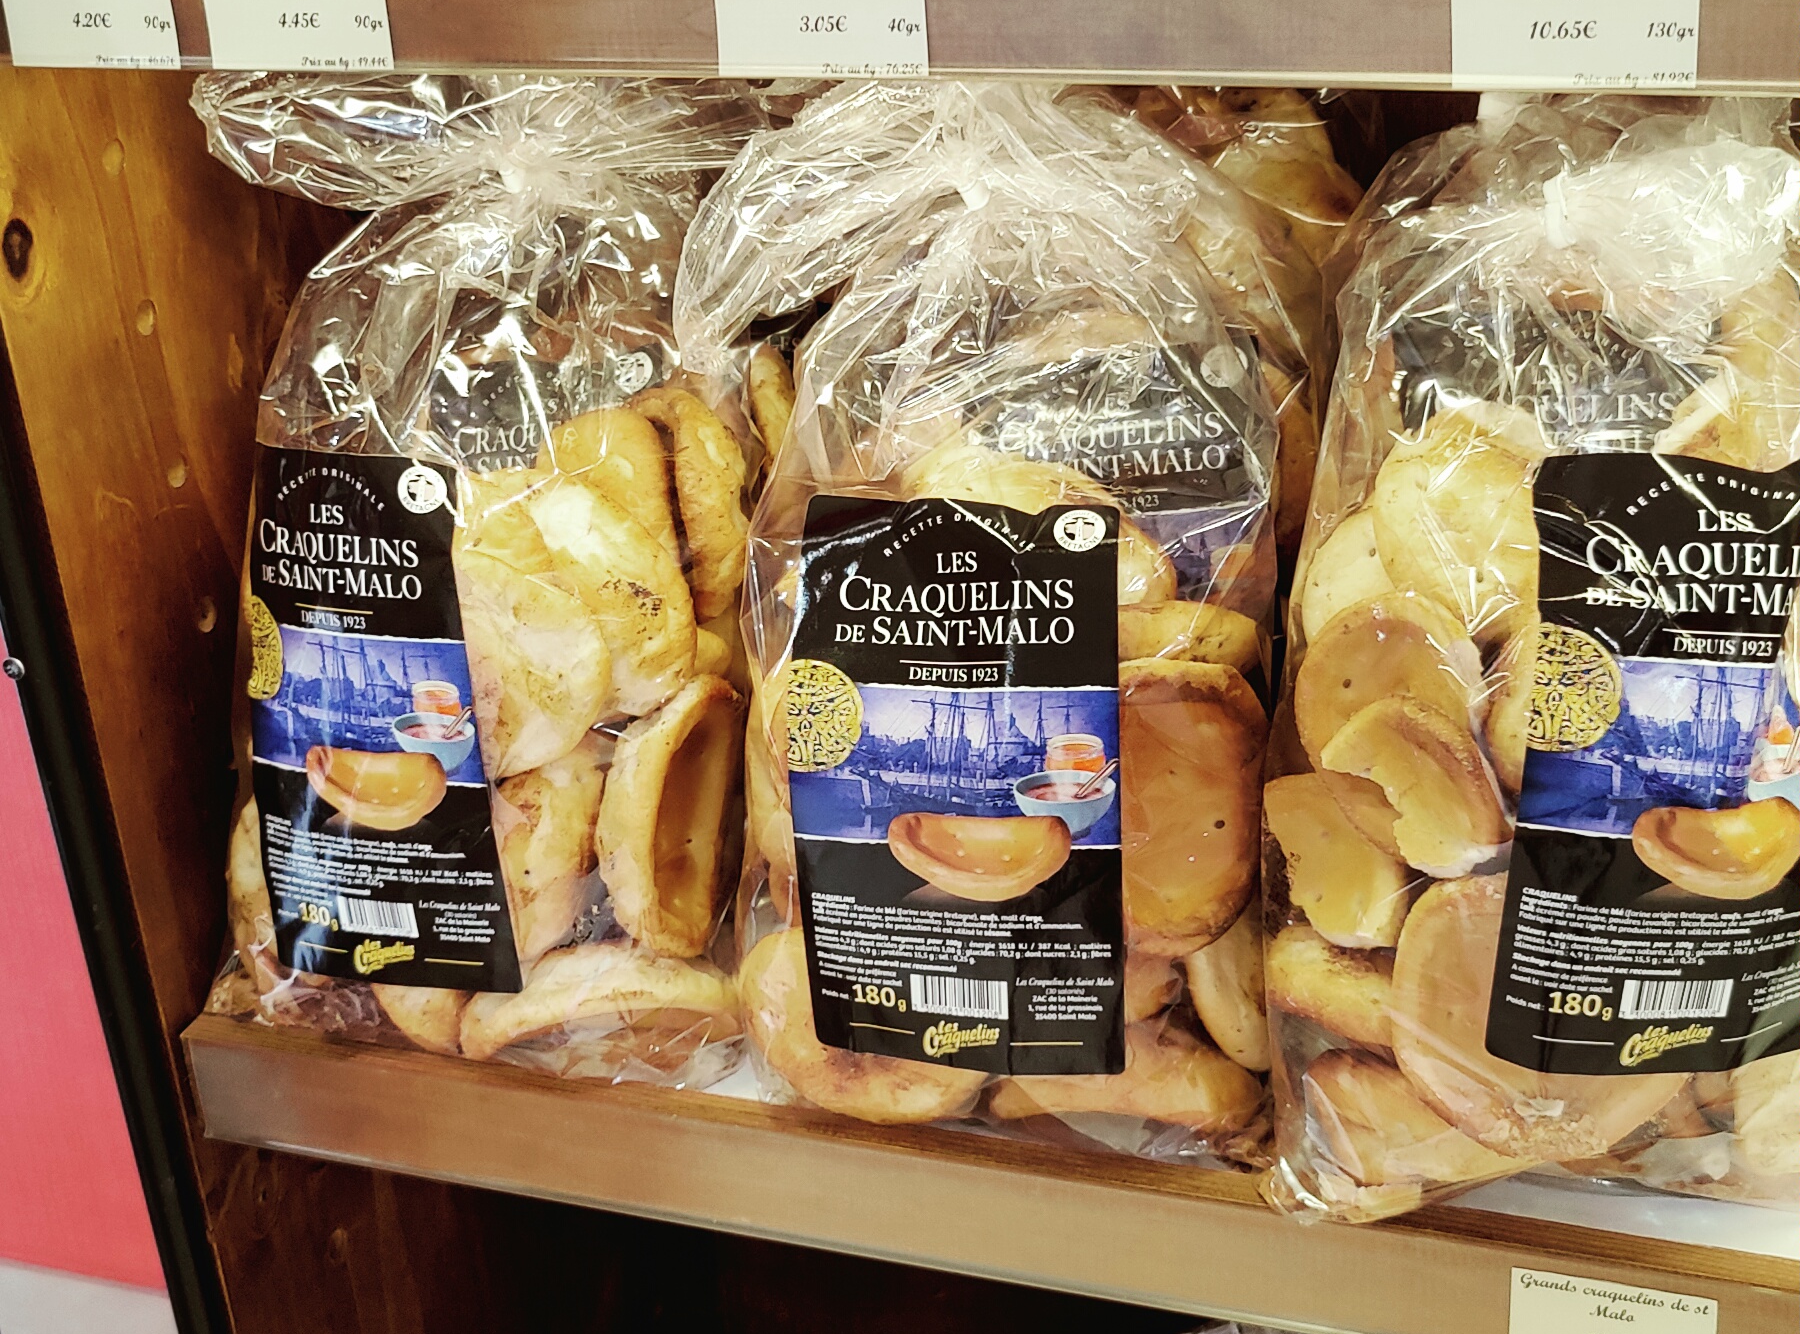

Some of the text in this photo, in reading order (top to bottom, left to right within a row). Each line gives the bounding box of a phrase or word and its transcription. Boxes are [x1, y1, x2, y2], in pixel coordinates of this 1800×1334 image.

[72, 12, 171, 31] 4.20€ 90gr
[278, 13, 383, 32] 4.45€ 90gr
[800, 16, 921, 36] 3.05€ 40gr
[1530, 20, 1695, 41] 10.65€ 130gr
[309, 503, 344, 525] LES
[1698, 509, 1754, 532] LES
[260, 519, 419, 568] CRAQUELINS
[883, 514, 944, 557] RECETTE
[937, 550, 978, 574] LES
[262, 559, 422, 600] DE SAINT-MALO
[839, 576, 1074, 614] CRAQUELINS
[301, 610, 366, 629] DEPUIS 1923
[835, 616, 1075, 646] DE SAINT-MALO
[1673, 636, 1773, 656] DEPUIS 1923
[909, 666, 999, 683] DEPUIS 1923
[298, 901, 330, 926] 180
[852, 983, 896, 1008] 180
[1548, 991, 1601, 1017] 180
[1520, 1273, 1709, 1315] Grands craquelins de st
[1589, 1305, 1635, 1323] Malo
